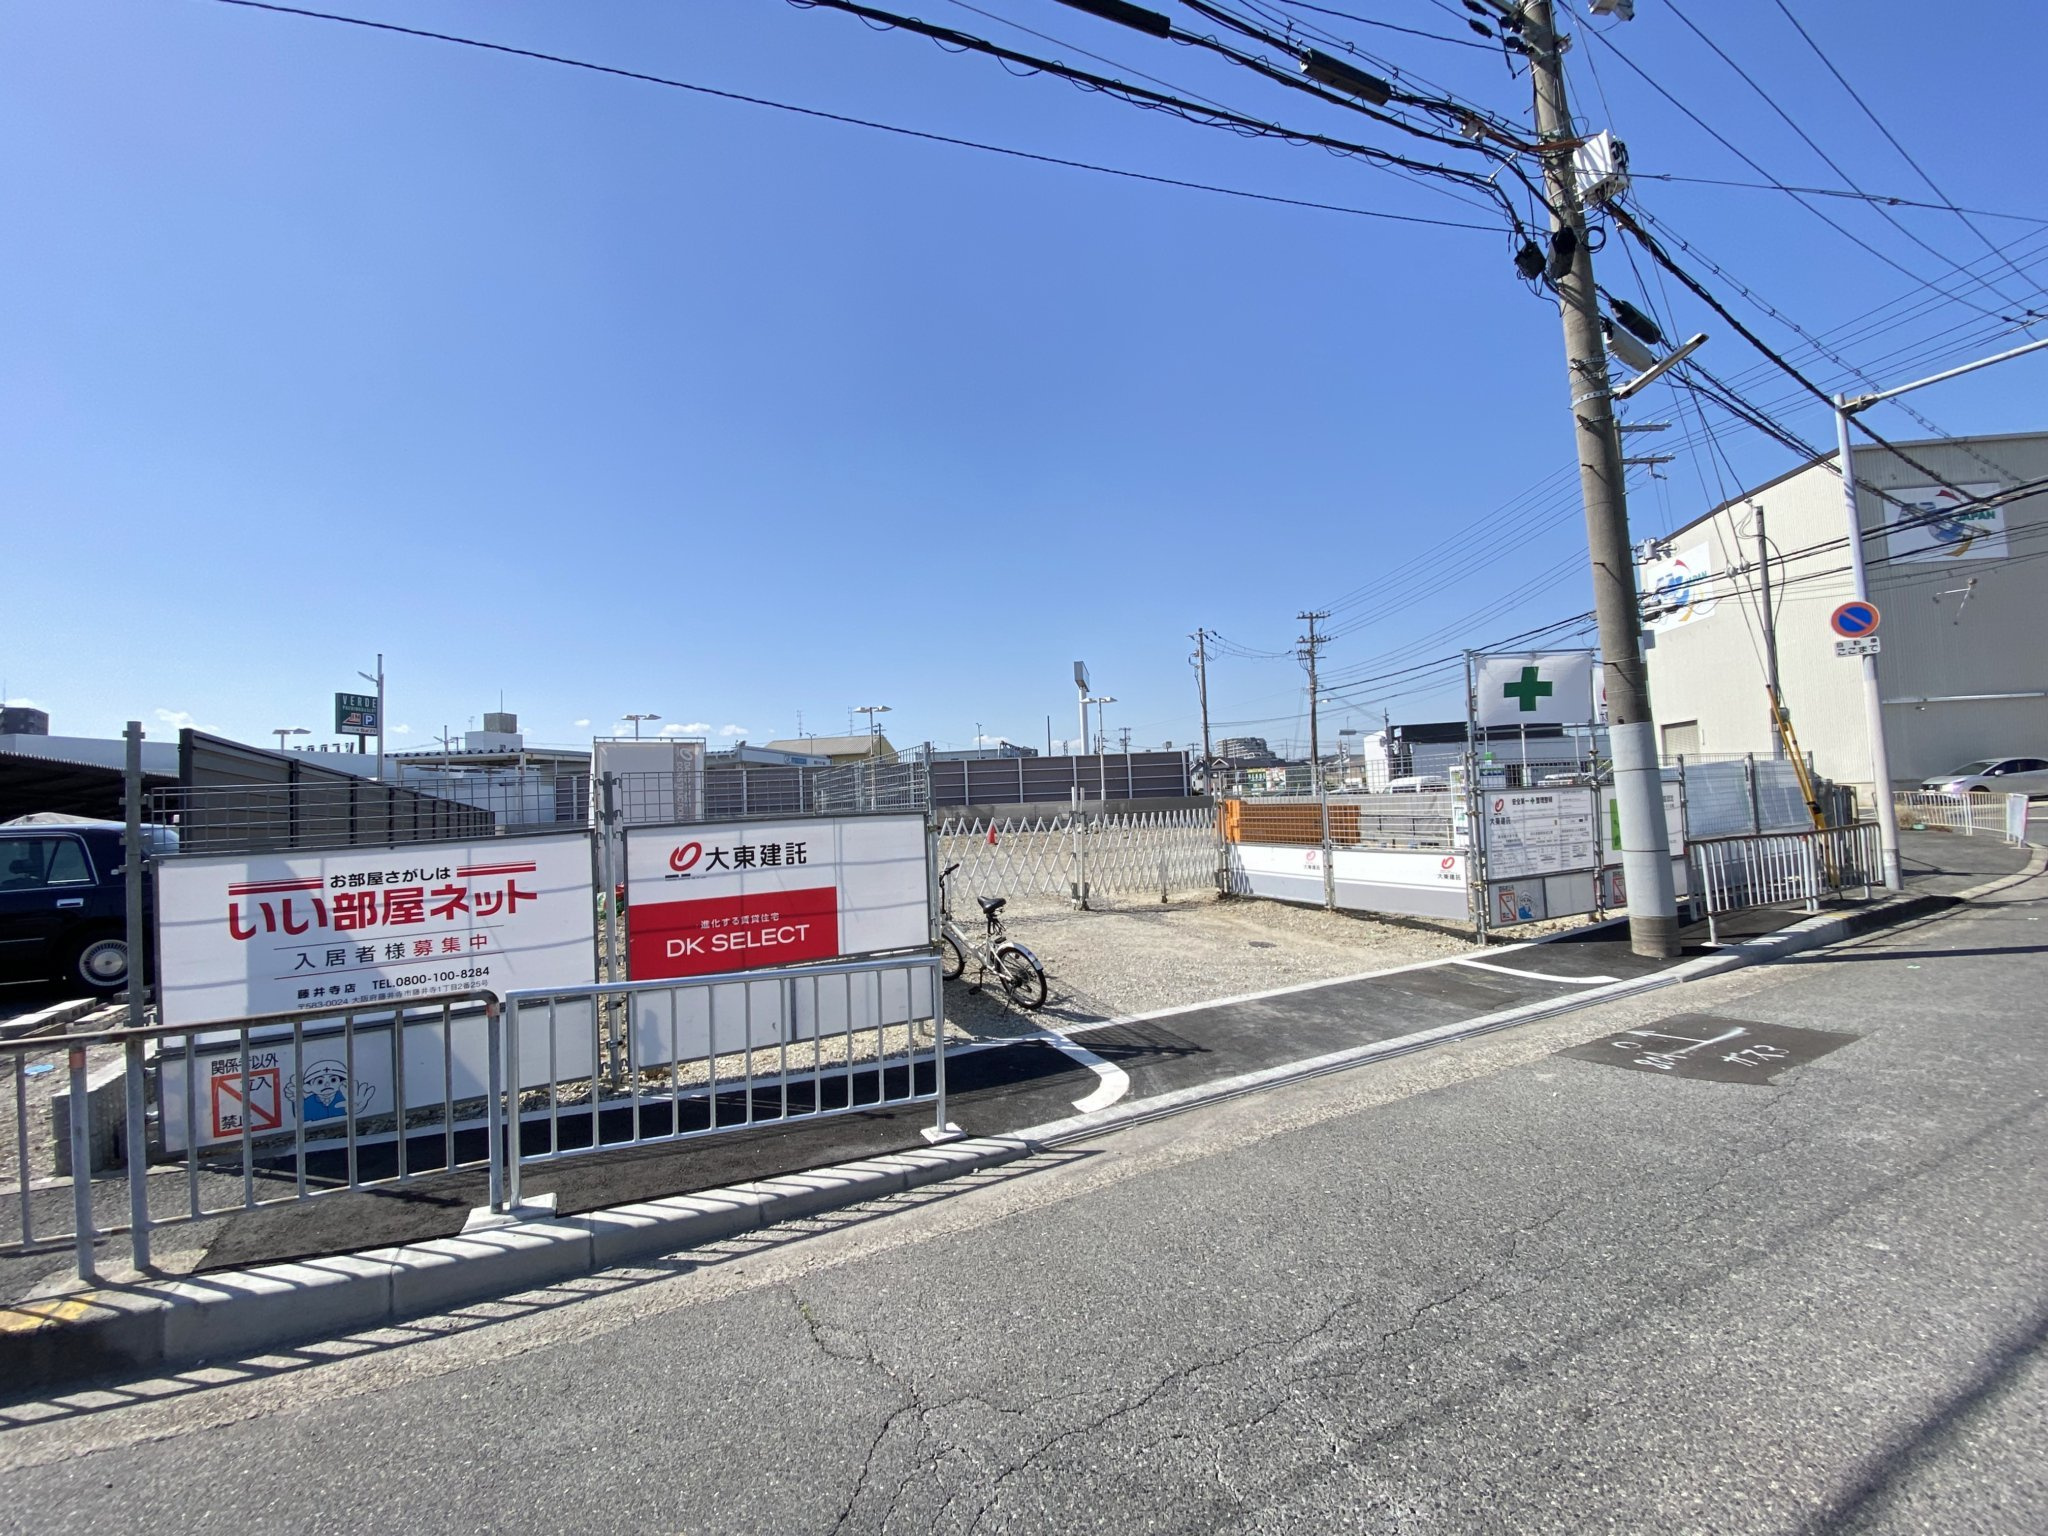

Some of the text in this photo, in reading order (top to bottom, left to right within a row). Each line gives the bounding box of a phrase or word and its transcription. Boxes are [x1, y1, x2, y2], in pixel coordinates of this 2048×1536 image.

[1837, 645, 1879, 656] ここまで
[342, 695, 377, 709] VERDE
[365, 715, 373, 725] P
[705, 841, 808, 872] 大東建託
[330, 867, 452, 888] お部屋さがしは
[228, 879, 538, 940] いい部屋ネット
[700, 911, 780, 930] 進化する賃貸住宅
[294, 933, 488, 970] 入居者様募集中
[666, 924, 810, 958] DK SELECT
[297, 966, 490, 999] 藤井寺店 TEL.0800-100-8284
[212, 1053, 279, 1075] 関係以外
